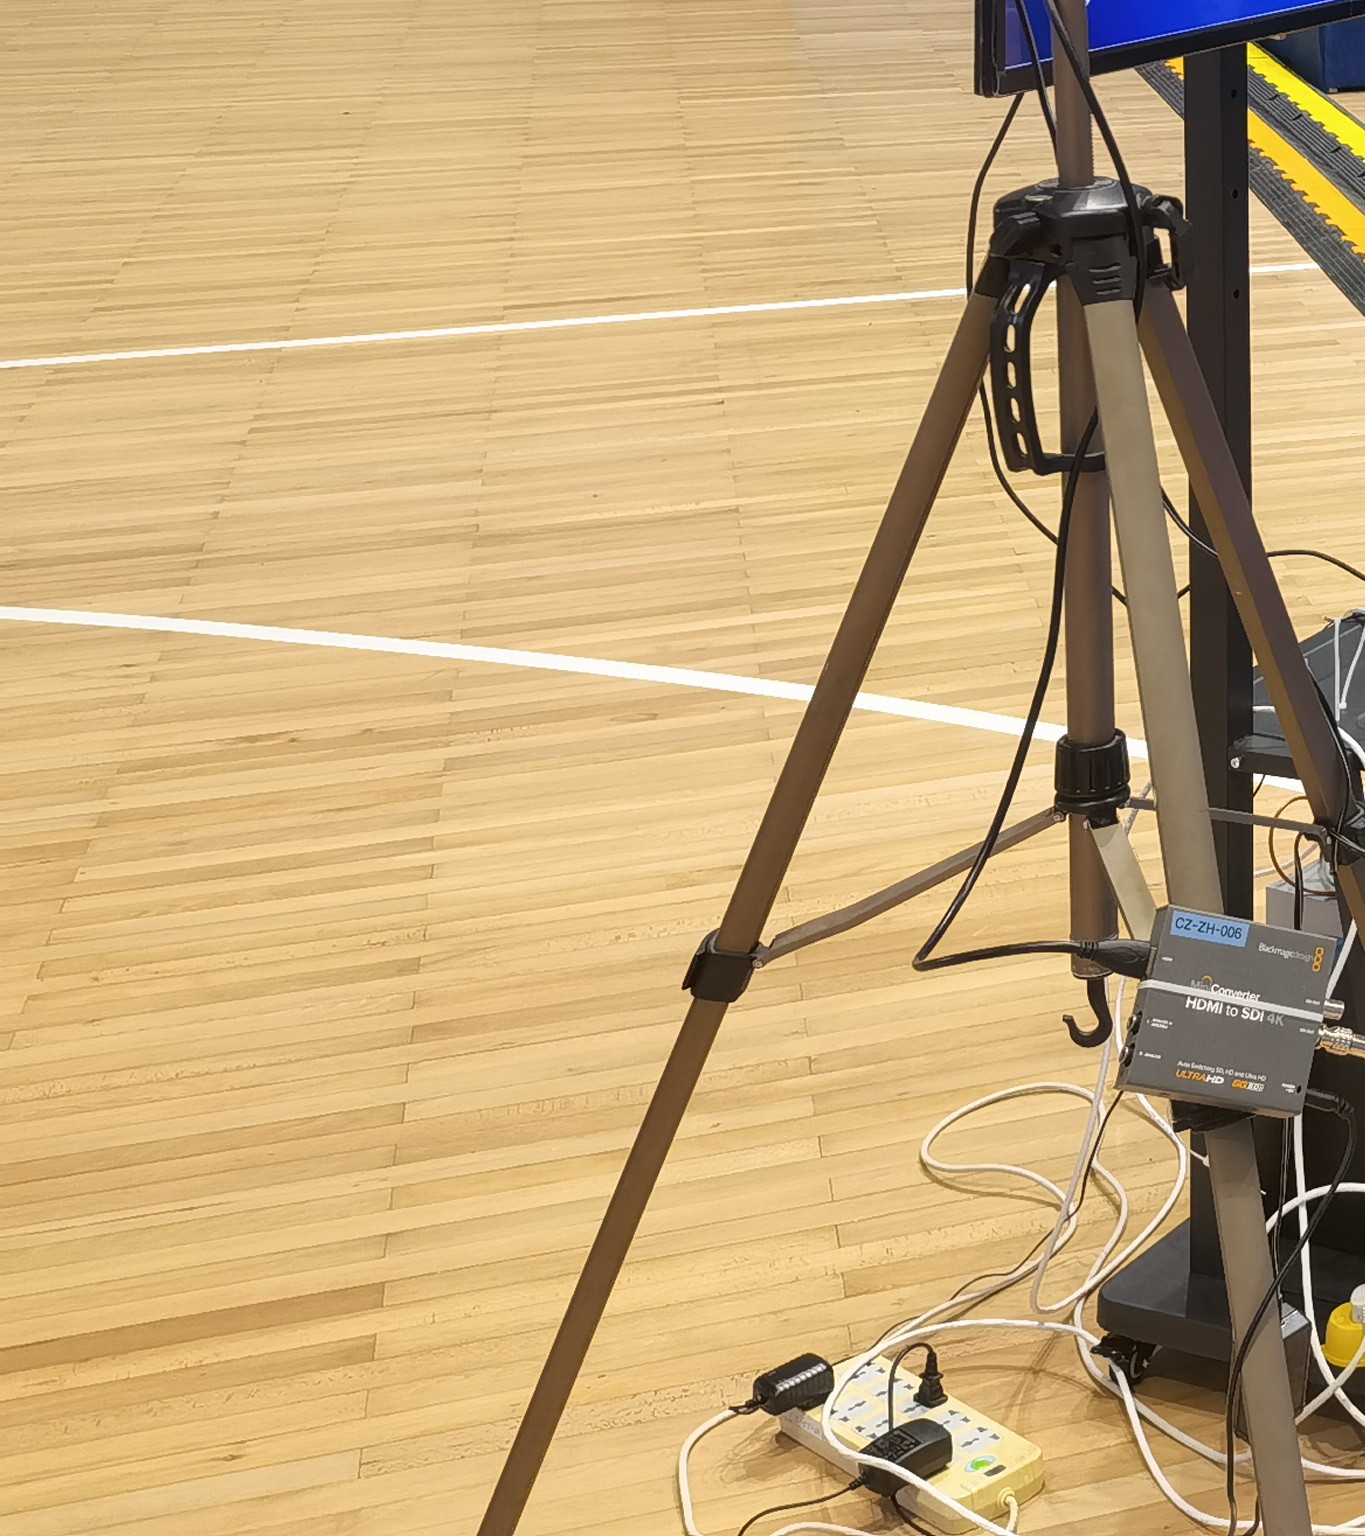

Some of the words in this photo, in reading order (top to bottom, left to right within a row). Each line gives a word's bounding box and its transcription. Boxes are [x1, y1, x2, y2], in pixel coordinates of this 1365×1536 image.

[1174, 917, 1243, 940] CZ-ZH-006
[1185, 996, 1223, 1014] HDMI
[1226, 1003, 1238, 1016] to
[1241, 1007, 1264, 1022] SDI
[1266, 1013, 1285, 1026] 4K
